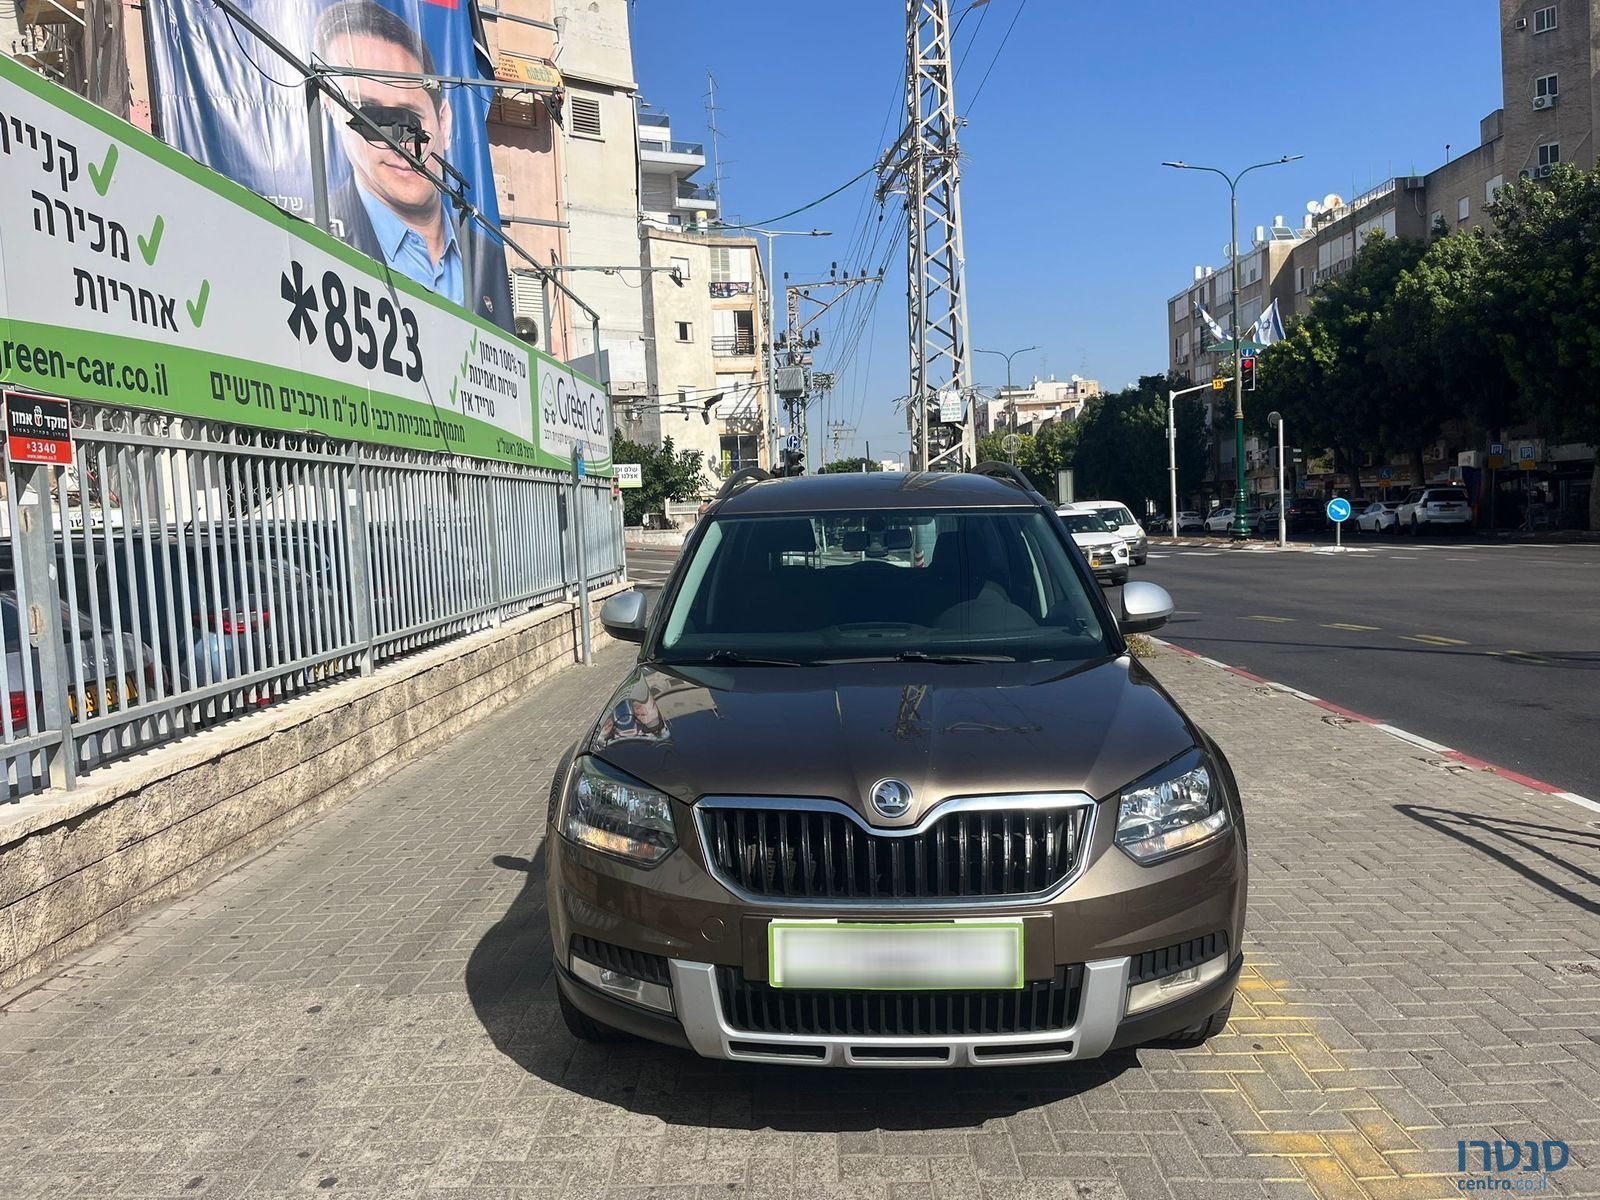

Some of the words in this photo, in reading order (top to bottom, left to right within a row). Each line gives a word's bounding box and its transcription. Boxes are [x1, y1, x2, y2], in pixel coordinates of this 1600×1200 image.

[31, 189, 130, 262] מכירה
[73, 267, 179, 333] אחריות
[480, 341, 499, 365] מימון
[499, 348, 517, 374] 100%
[0, 340, 168, 396] reen-car.co.il
[469, 364, 498, 391] ואמינות
[517, 360, 526, 379] עד
[210, 370, 275, 410] חדשים
[498, 376, 518, 399] שירות
[1215, 380, 1222, 388] 13
[279, 386, 329, 420] ורכבים
[461, 390, 474, 416] אין
[474, 394, 495, 417] טרייד
[557, 377, 590, 432] Green
[590, 393, 605, 436] Car
[11, 411, 33, 427] אמון
[43, 415, 68, 431] מוקד
[371, 407, 396, 432] רכבי
[397, 413, 433, 438] במכירת
